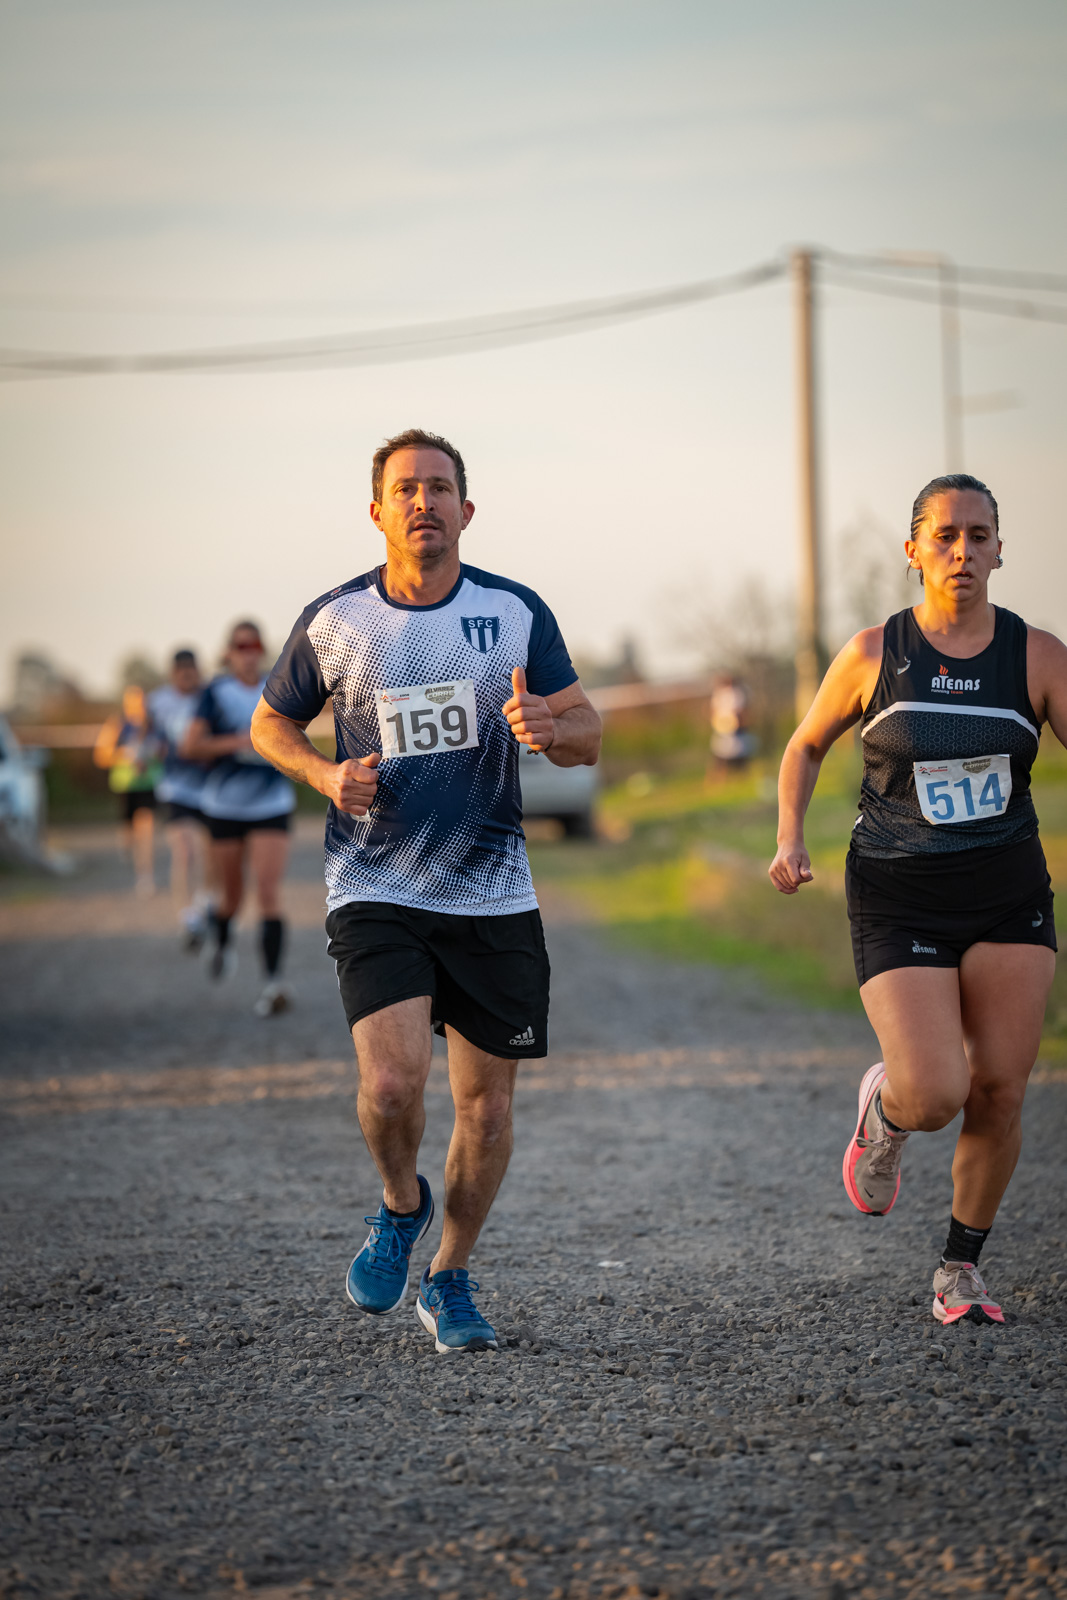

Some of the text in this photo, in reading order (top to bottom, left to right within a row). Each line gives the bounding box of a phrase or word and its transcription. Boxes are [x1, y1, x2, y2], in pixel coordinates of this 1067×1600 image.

[468, 619, 493, 628] SFC
[931, 675, 981, 691] ATENAS
[426, 690, 455, 699] CORRE
[386, 705, 469, 754] 159
[926, 772, 1006, 821] 514
